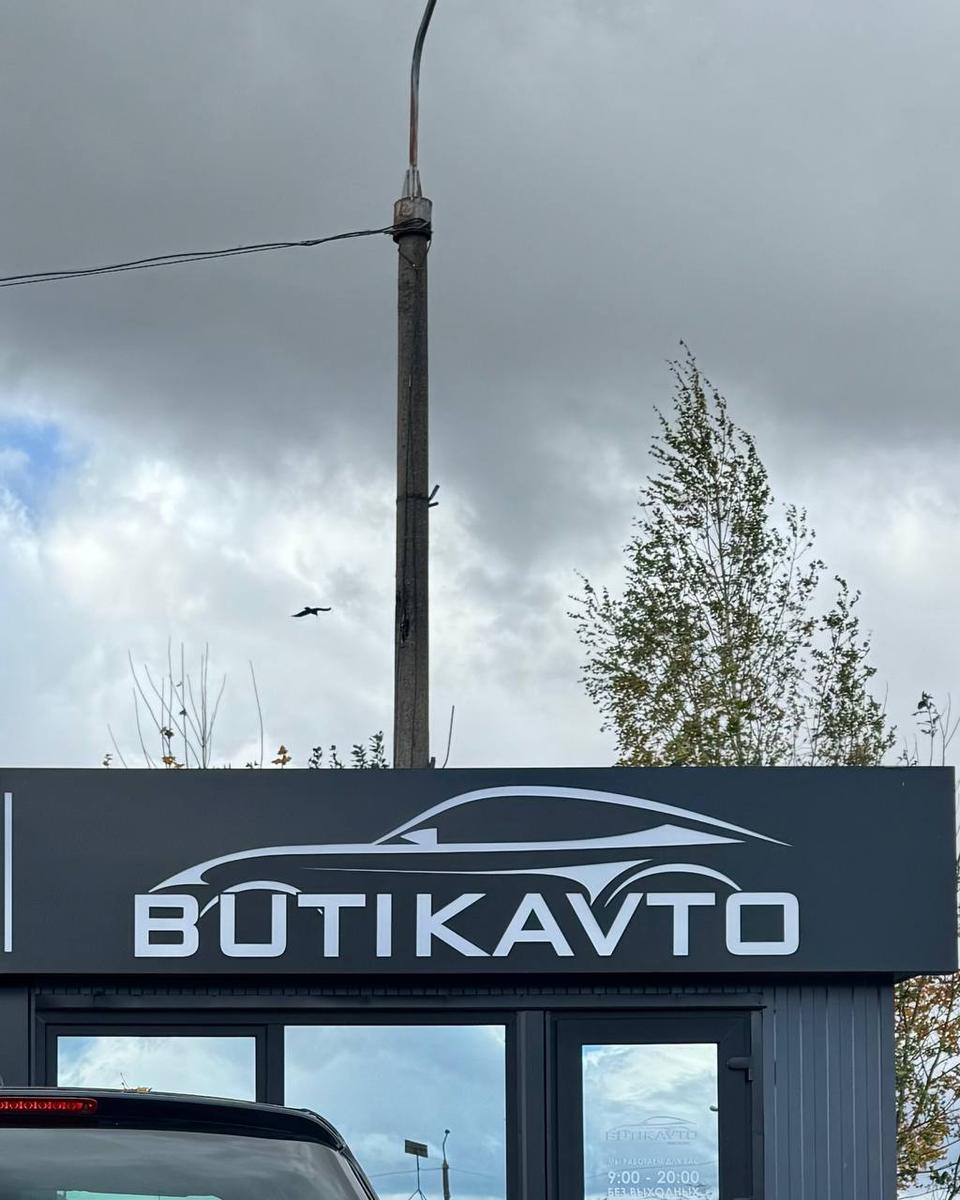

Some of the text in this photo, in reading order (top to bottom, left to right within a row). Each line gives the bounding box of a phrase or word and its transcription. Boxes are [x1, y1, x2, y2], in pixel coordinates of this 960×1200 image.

[133, 892, 800, 958] BUTIKAVTO
[608, 1170, 640, 1184] 9:00
[656, 1170, 700, 1184] 20:00
[607, 1187, 626, 1198] БЕЗ
